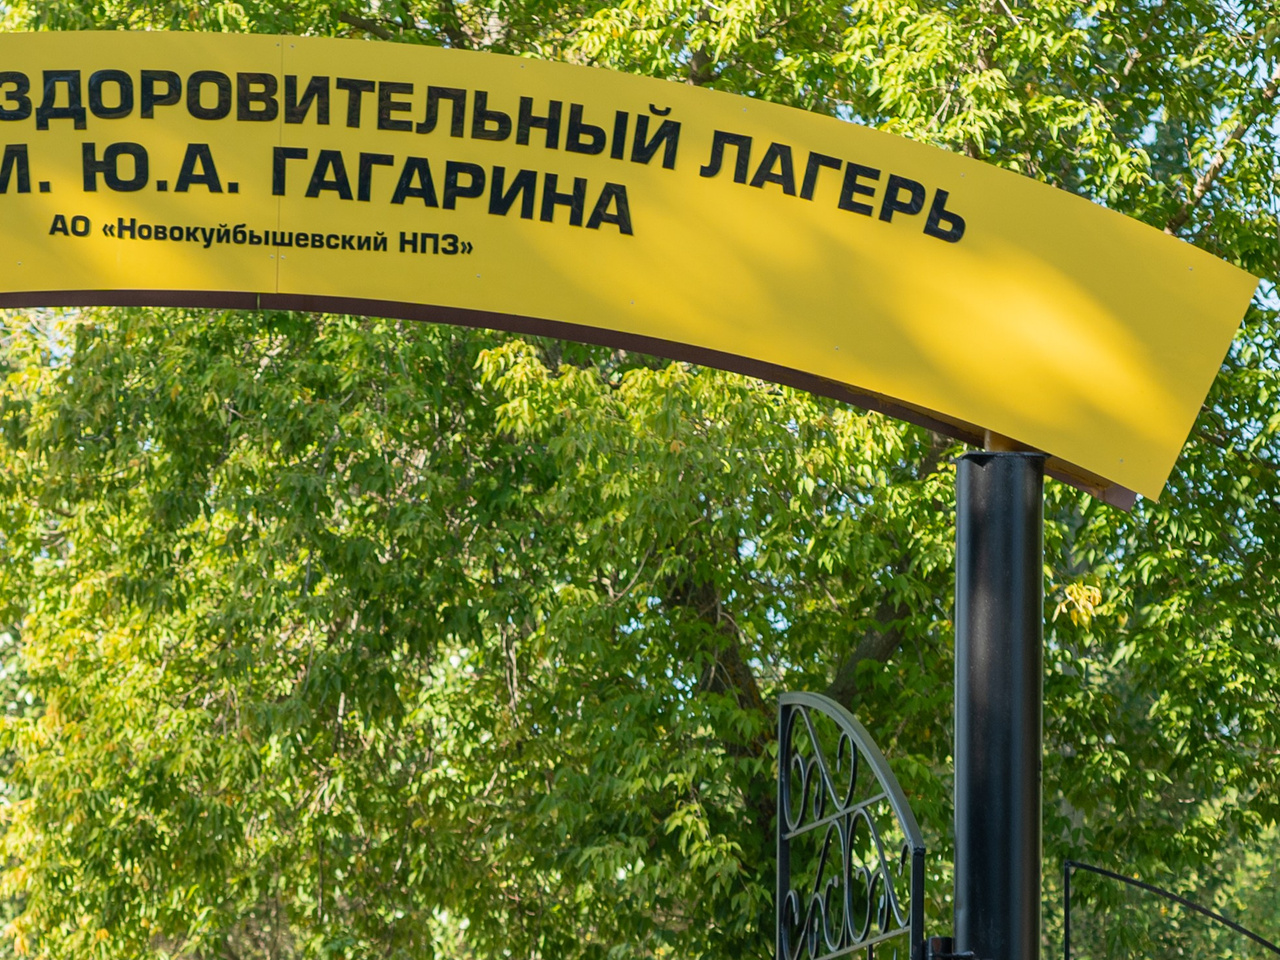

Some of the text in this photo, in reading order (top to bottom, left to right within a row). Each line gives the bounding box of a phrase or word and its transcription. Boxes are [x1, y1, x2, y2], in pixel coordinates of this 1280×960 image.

[81, 141, 240, 193] Ю.А.
[271, 146, 635, 236] ГАГАРИНА
[699, 129, 967, 243] ЛАГЕРЬ
[48, 214, 474, 256] АО «Новокуйбышевский НПЗ»
